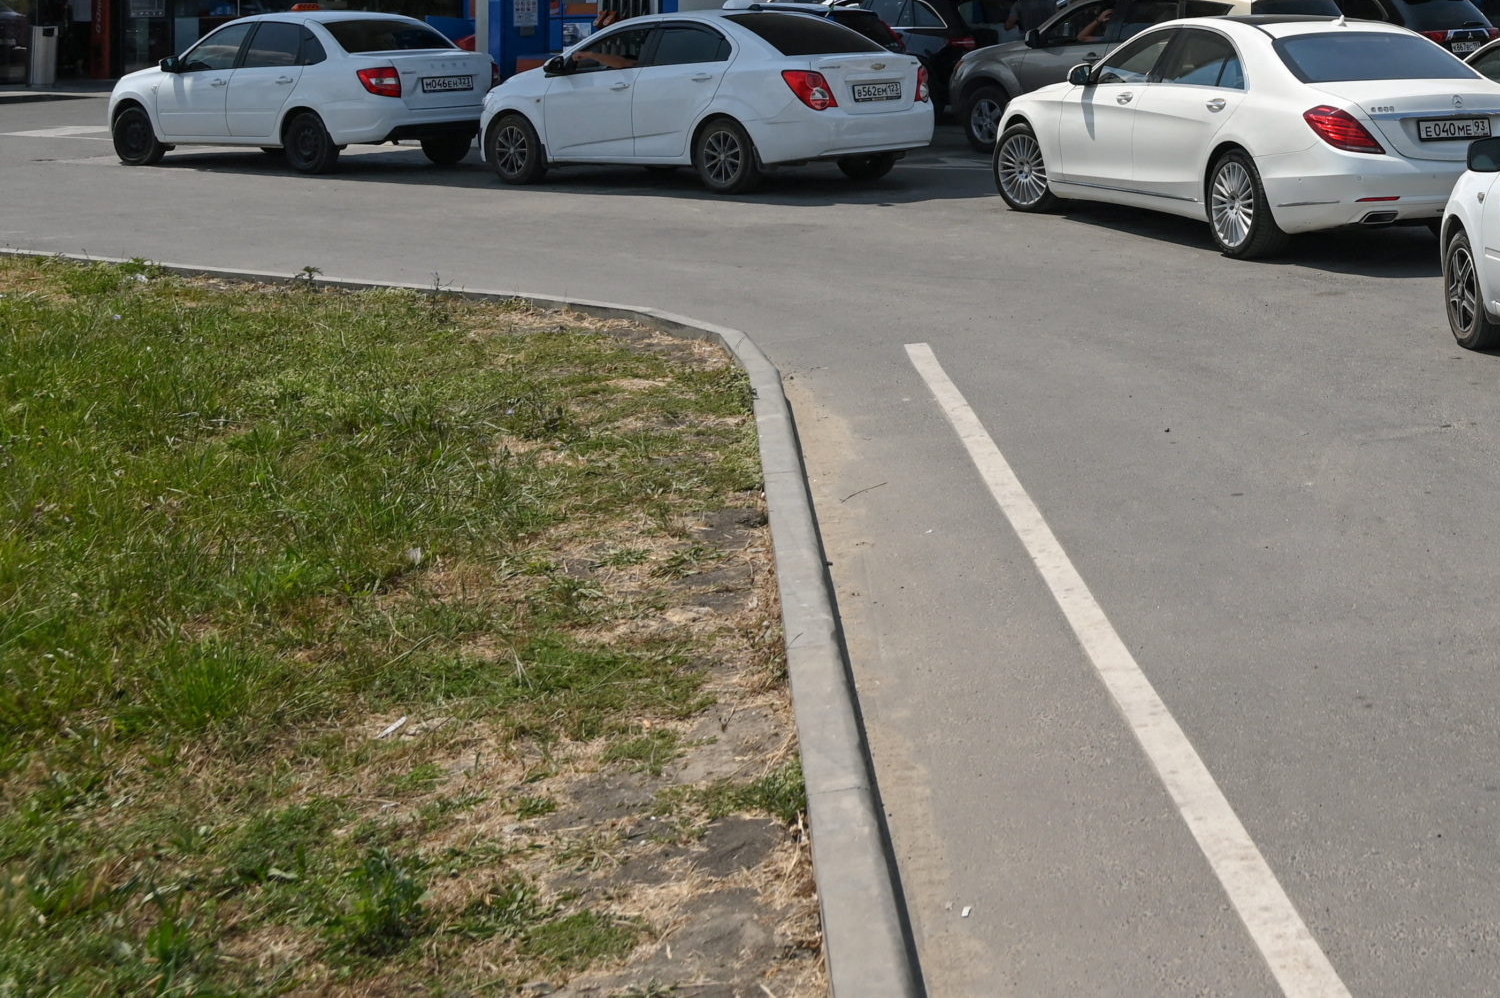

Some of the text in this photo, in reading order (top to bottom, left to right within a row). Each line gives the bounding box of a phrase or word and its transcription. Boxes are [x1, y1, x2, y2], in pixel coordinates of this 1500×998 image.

[857, 83, 899, 98] В562ЕМ 123
[1425, 120, 1486, 138] Е040МЕ 93
